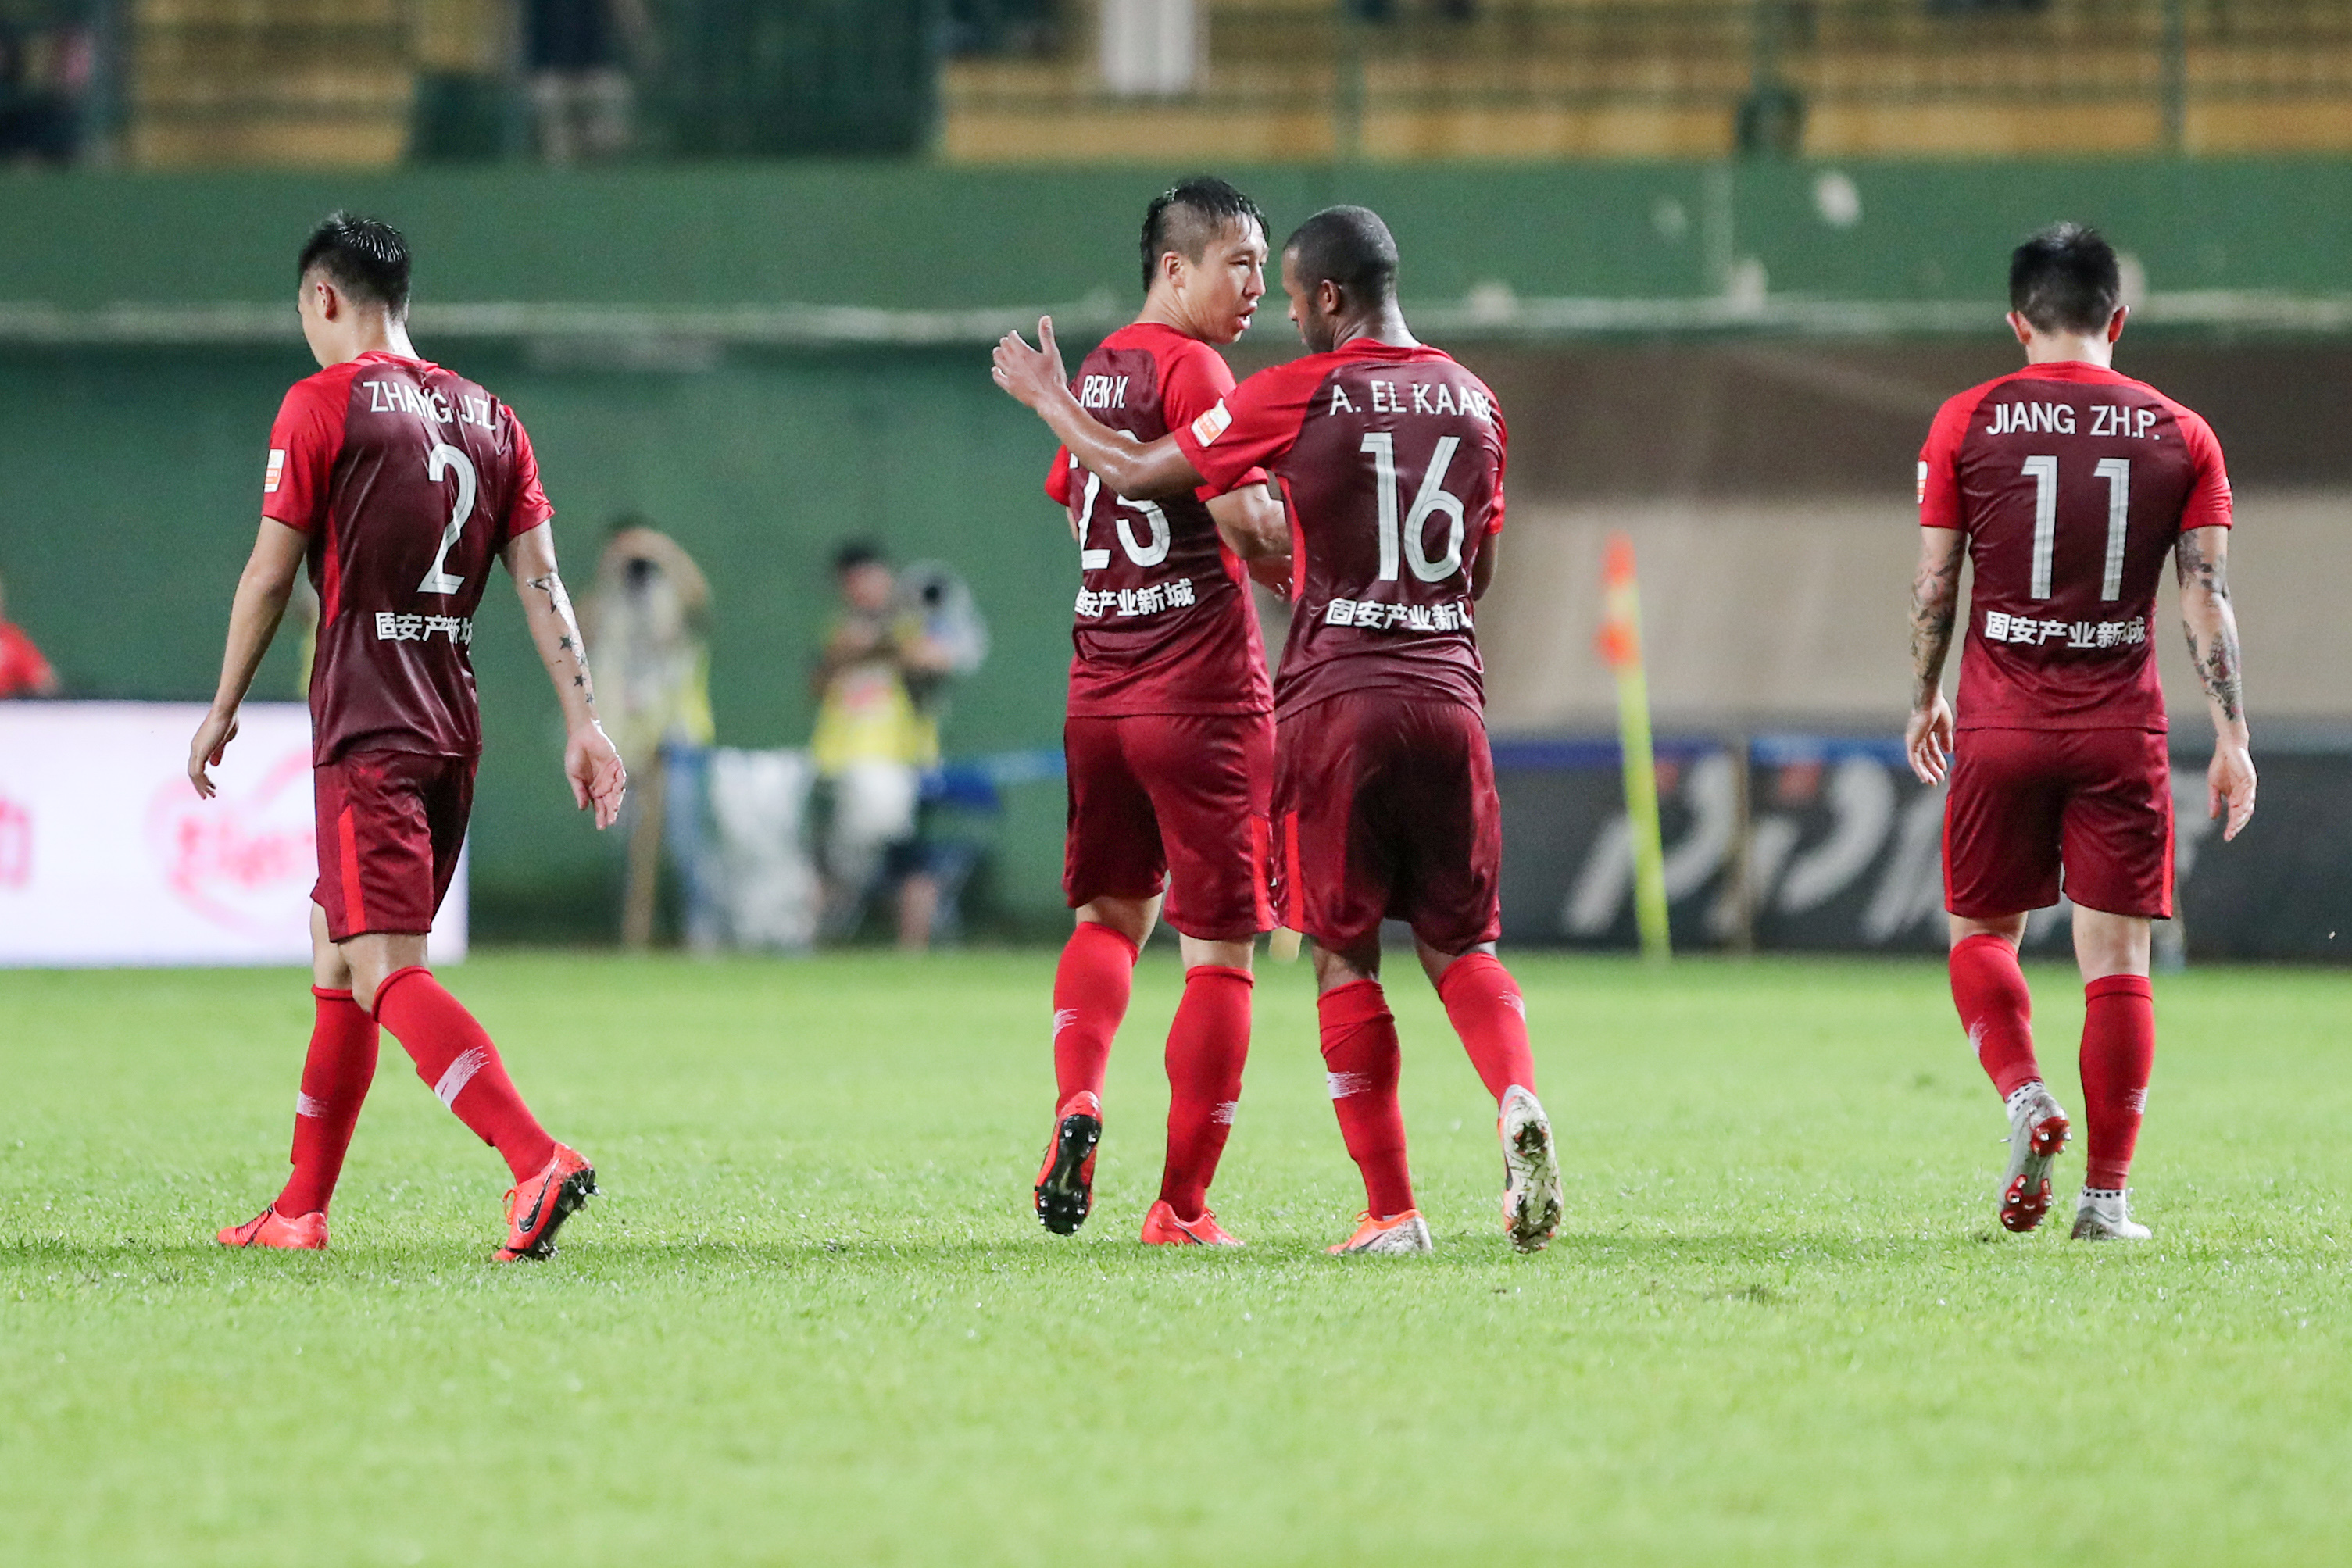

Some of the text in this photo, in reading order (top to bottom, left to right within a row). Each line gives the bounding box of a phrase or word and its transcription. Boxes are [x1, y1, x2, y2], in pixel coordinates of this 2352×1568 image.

[362, 380, 455, 424] ZHANG
[1080, 374, 1113, 409] REN
[1329, 383, 1362, 416] A.
[1370, 380, 1407, 413] EL
[1986, 402, 2076, 436] JIANG
[416, 442, 477, 595] 2
[1359, 431, 1465, 583] 16
[2021, 455, 2131, 601] 11
